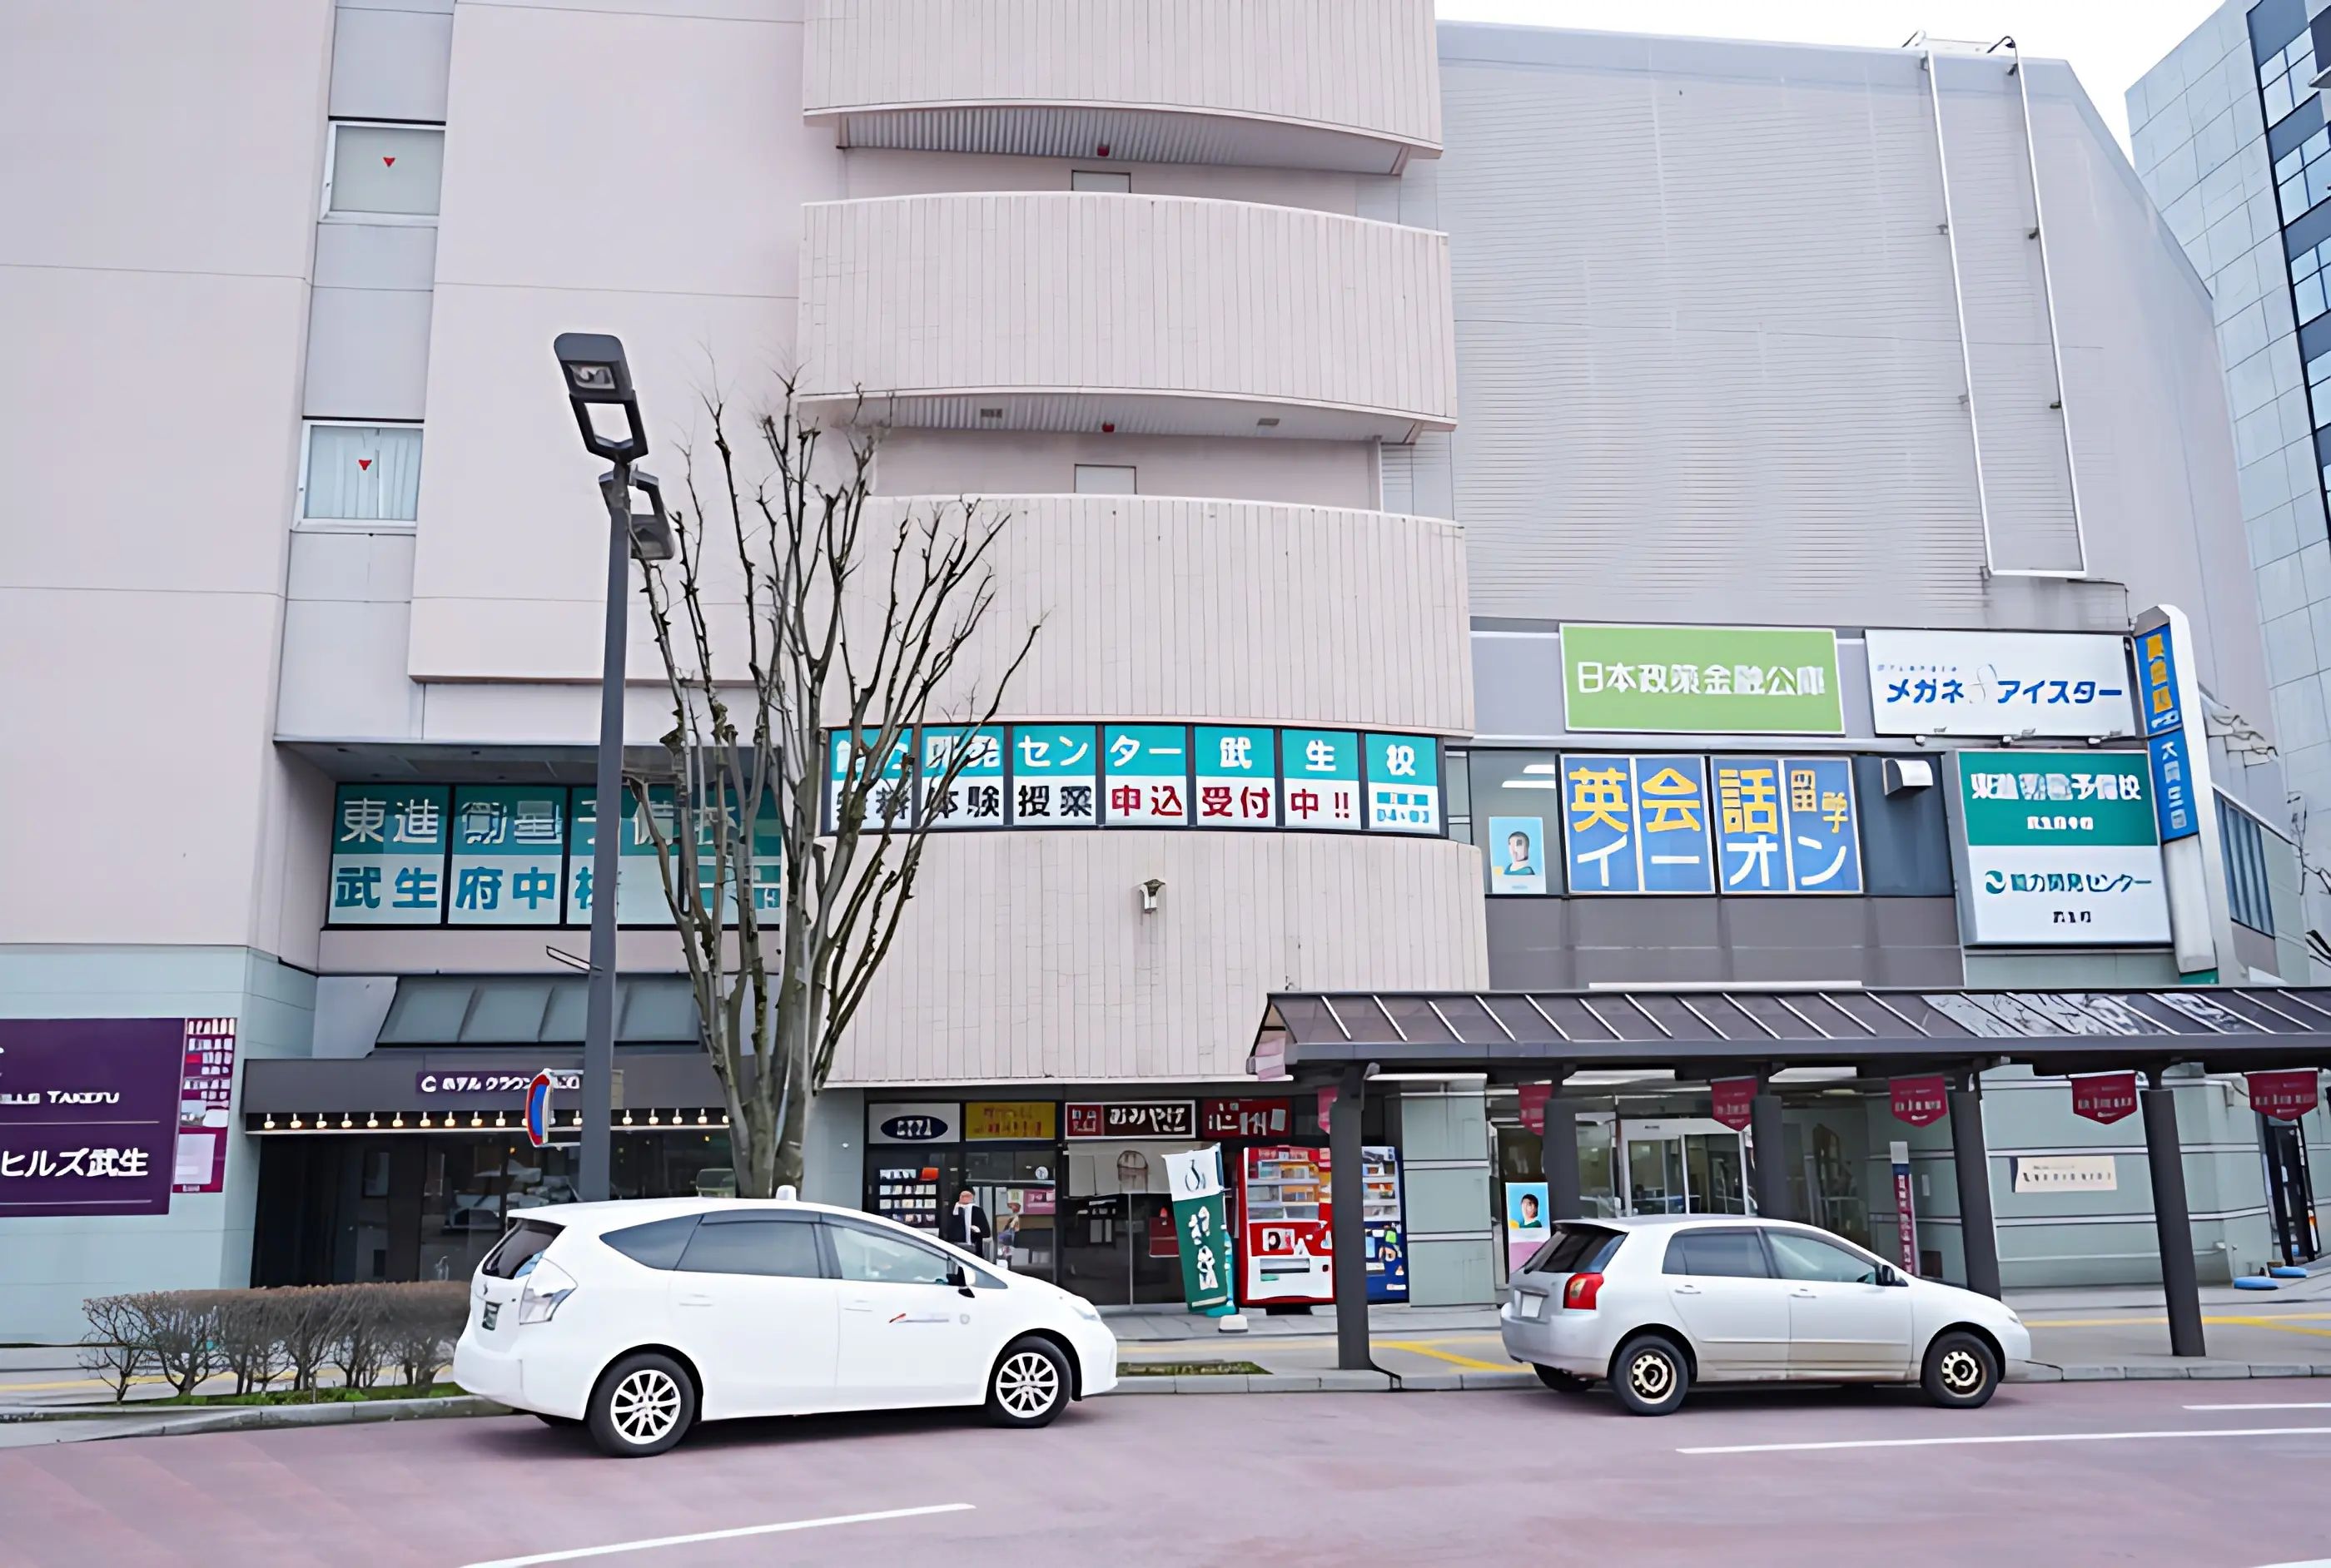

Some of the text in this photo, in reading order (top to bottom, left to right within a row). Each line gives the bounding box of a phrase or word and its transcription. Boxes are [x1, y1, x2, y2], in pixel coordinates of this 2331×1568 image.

[1886, 677, 2123, 705] メガネ アイスター
[1568, 767, 1778, 835] 英会話
[1576, 834, 1847, 889] イーオン
